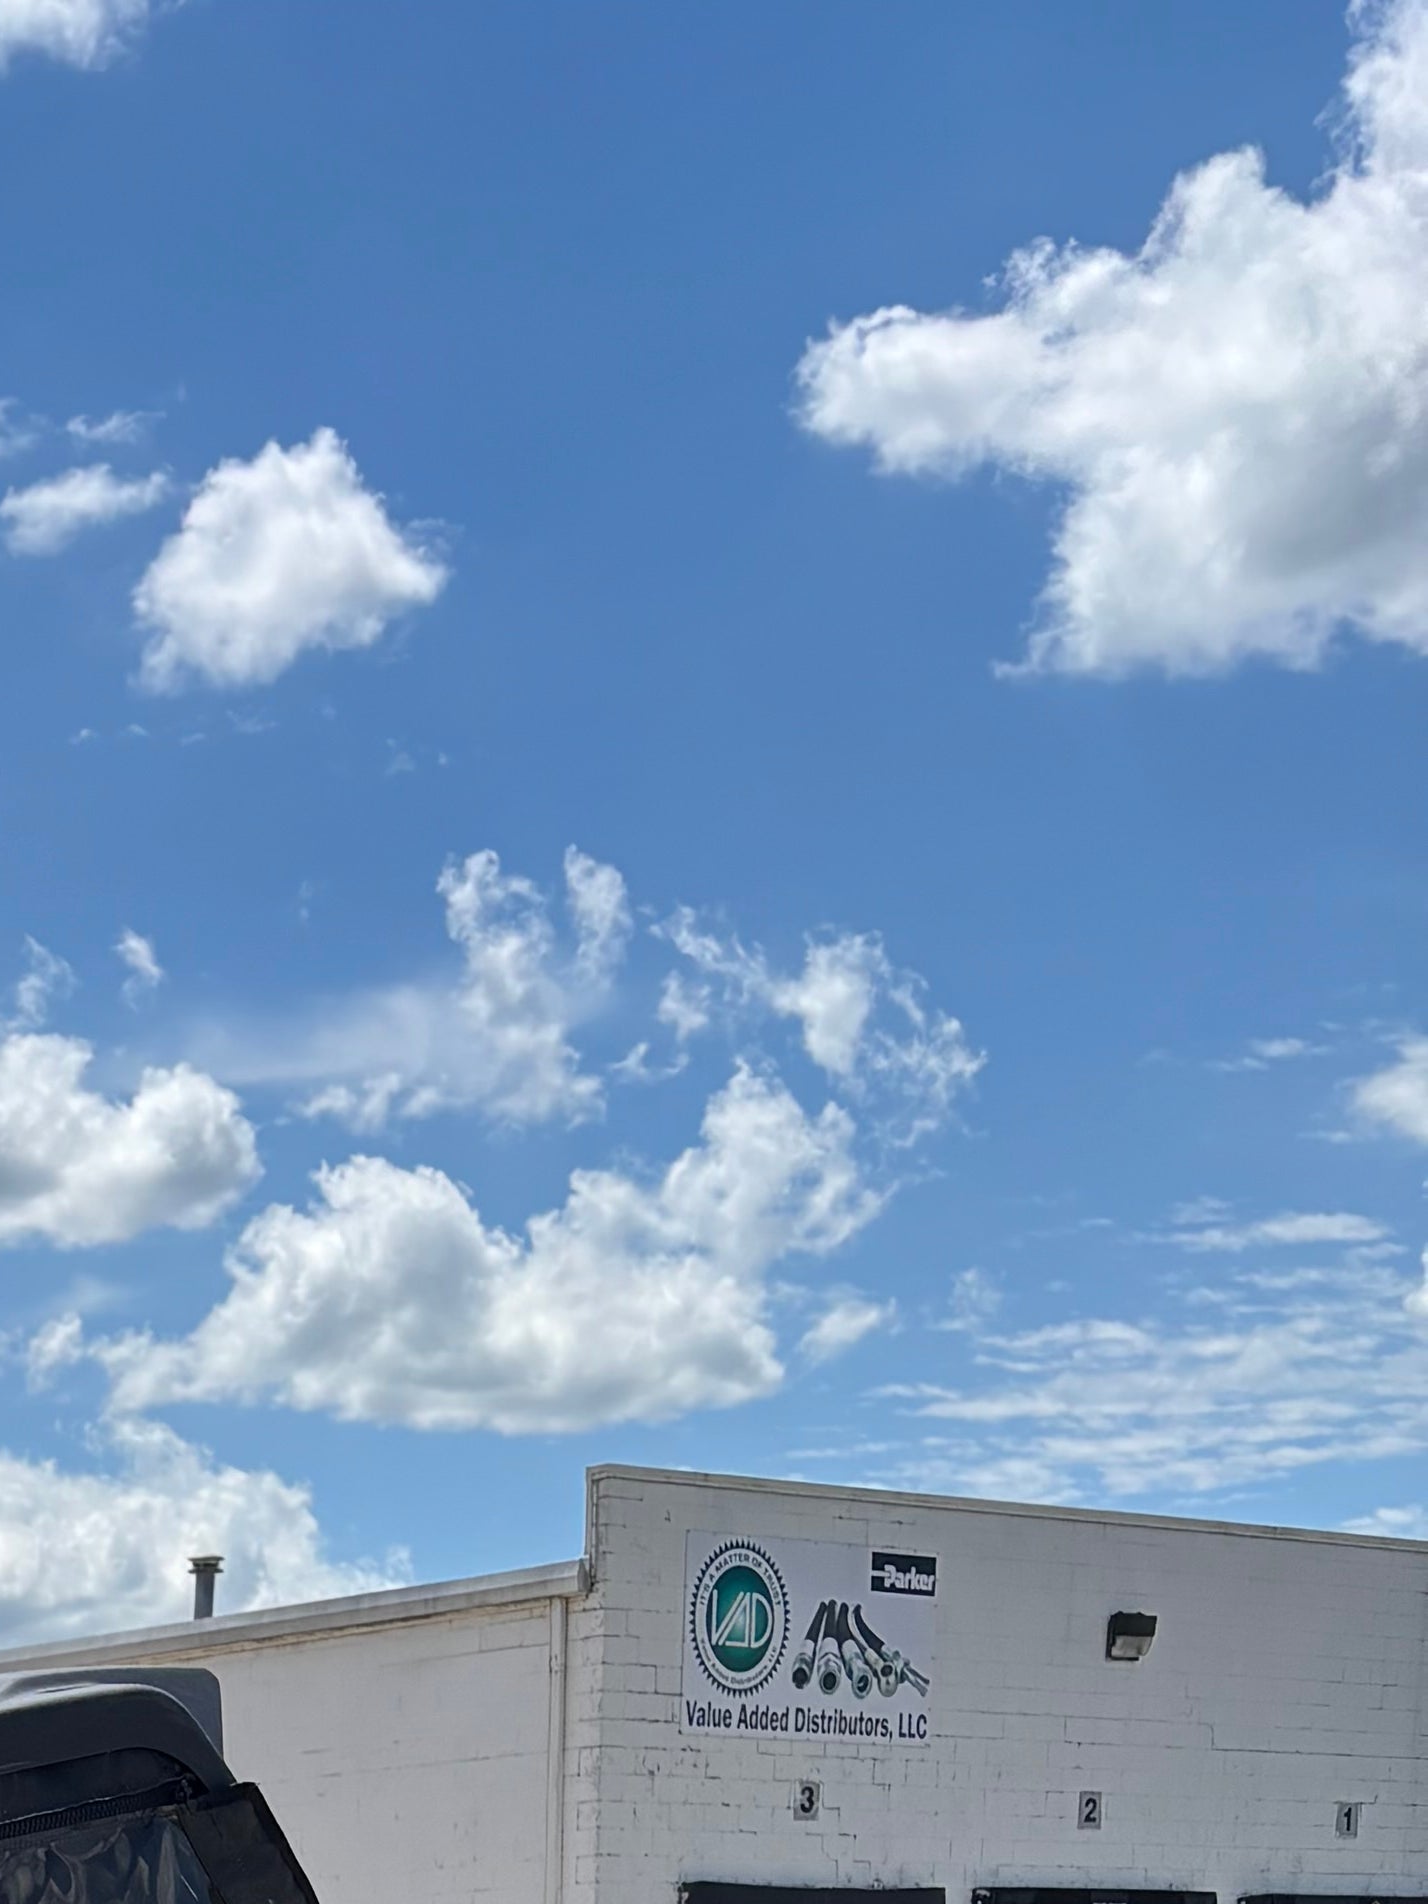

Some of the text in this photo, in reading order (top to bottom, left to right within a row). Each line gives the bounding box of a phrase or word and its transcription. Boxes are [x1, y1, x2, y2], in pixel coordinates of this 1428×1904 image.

[884, 1564, 935, 1591] Parker
[686, 1700, 927, 1743] Value Added Distributors, LLC
[800, 1786, 814, 1813] 3
[1084, 1797, 1097, 1823] 2
[1344, 1807, 1352, 1831] 1
